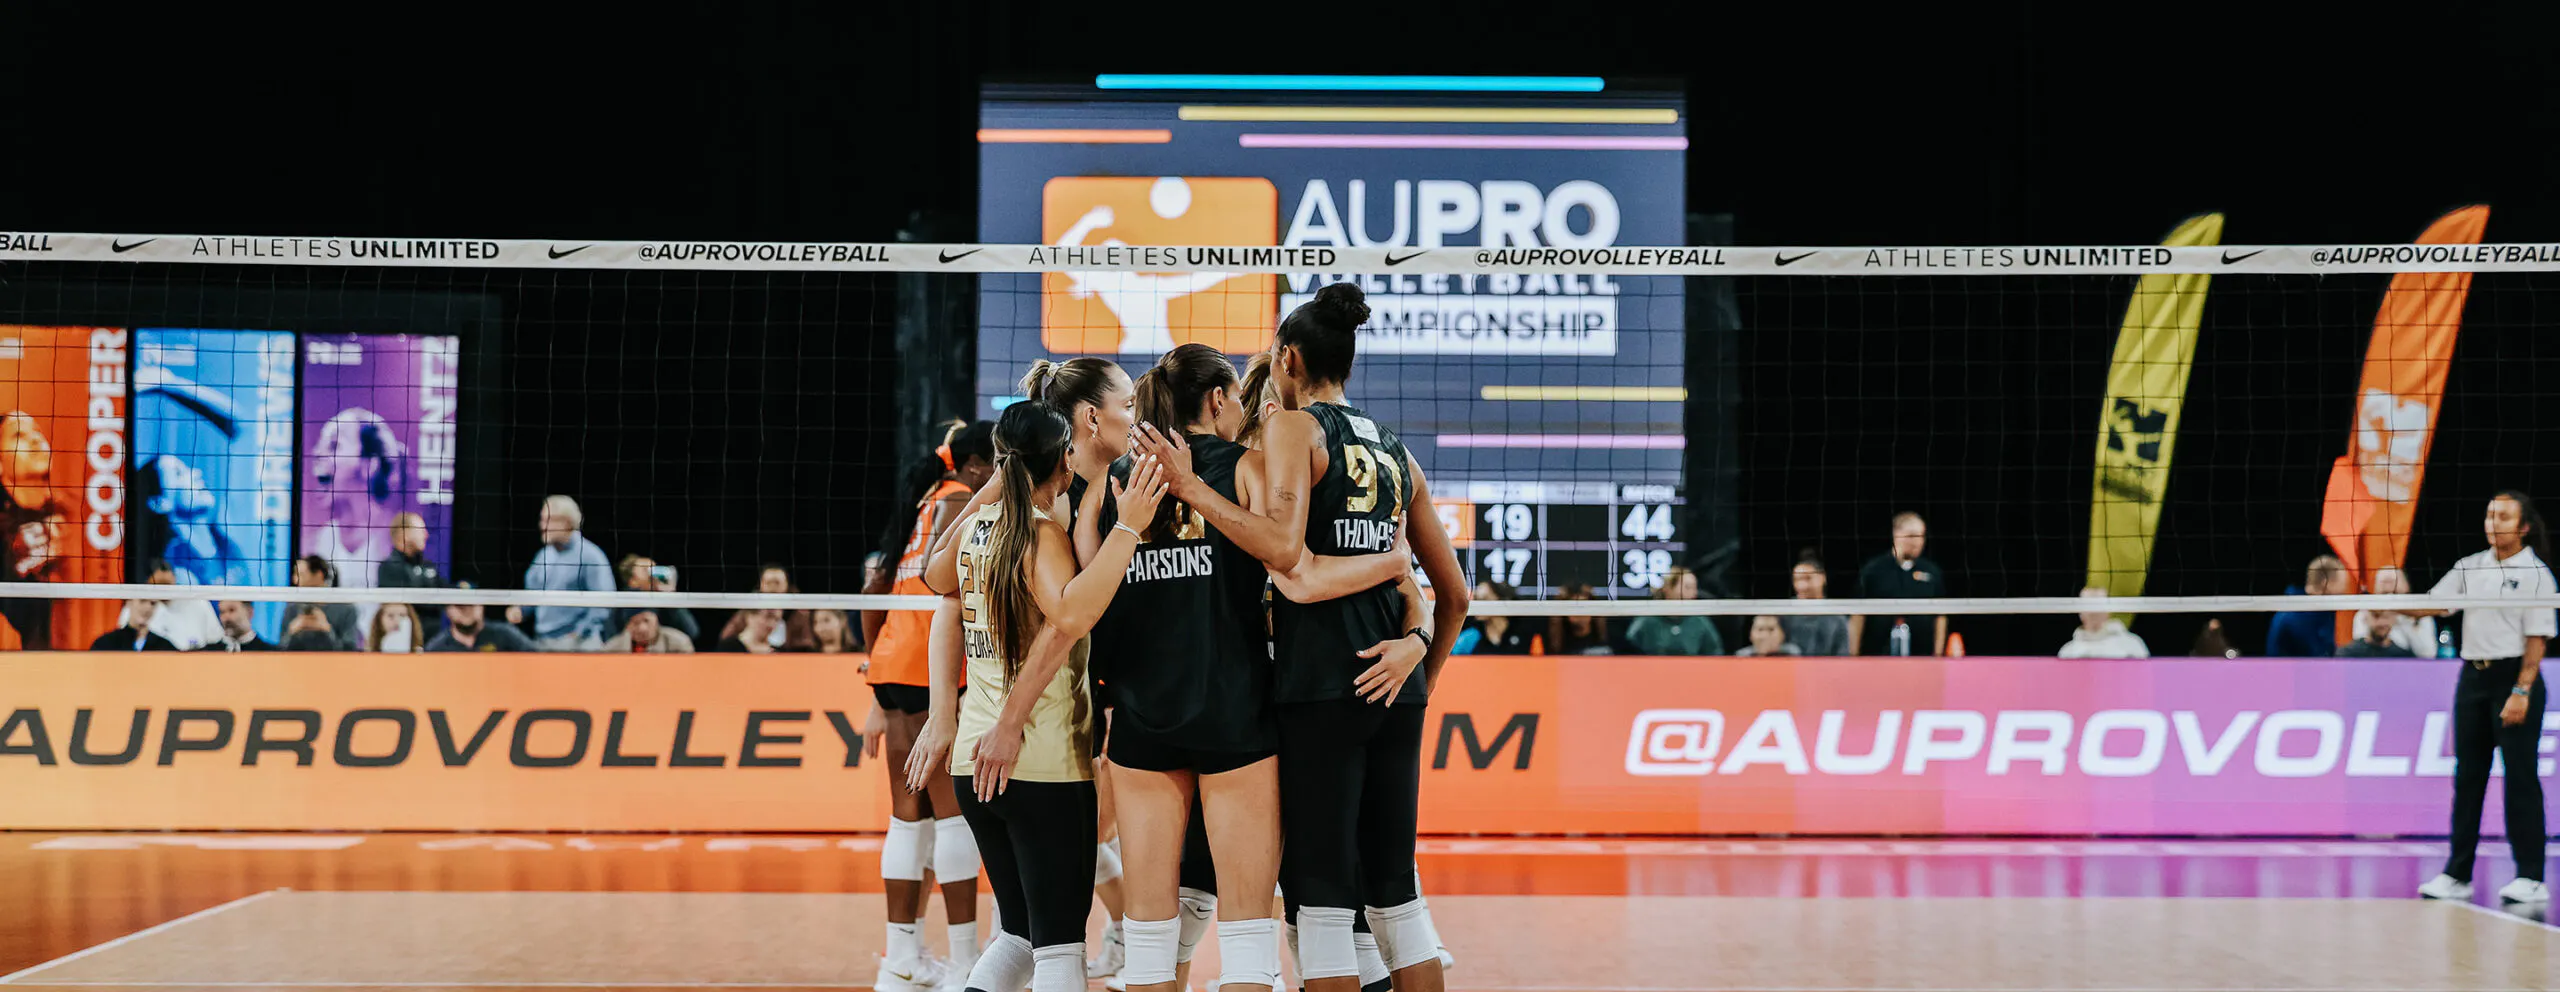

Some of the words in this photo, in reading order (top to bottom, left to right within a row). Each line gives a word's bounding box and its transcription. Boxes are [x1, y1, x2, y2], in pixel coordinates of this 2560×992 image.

[1283, 178, 1621, 246] AUPRO
[192, 236, 341, 259] ATHLETES
[350, 240, 500, 260] UNLIMITED
[638, 243, 890, 263] @AUPROVOLLEYBALL
[1028, 247, 1177, 266] ATHLETES
[1186, 248, 1337, 267] UNLIMITED
[1474, 248, 1727, 268] @AUPROVOLLEYBALL
[1864, 248, 2014, 268] ATHLETES
[2023, 248, 2173, 267] UNLIMITED
[2310, 245, 2560, 266] @AUPROVOLLEYBALL
[1357, 310, 1605, 341] AMPIONSHIP
[416, 335, 459, 505] HENTZ
[86, 327, 127, 551] COOPER
[1344, 444, 1403, 522] 97
[1483, 503, 1533, 541] 19
[1621, 503, 1676, 543] 44
[1126, 545, 1212, 584] PARSONS
[1483, 548, 1533, 587] 17
